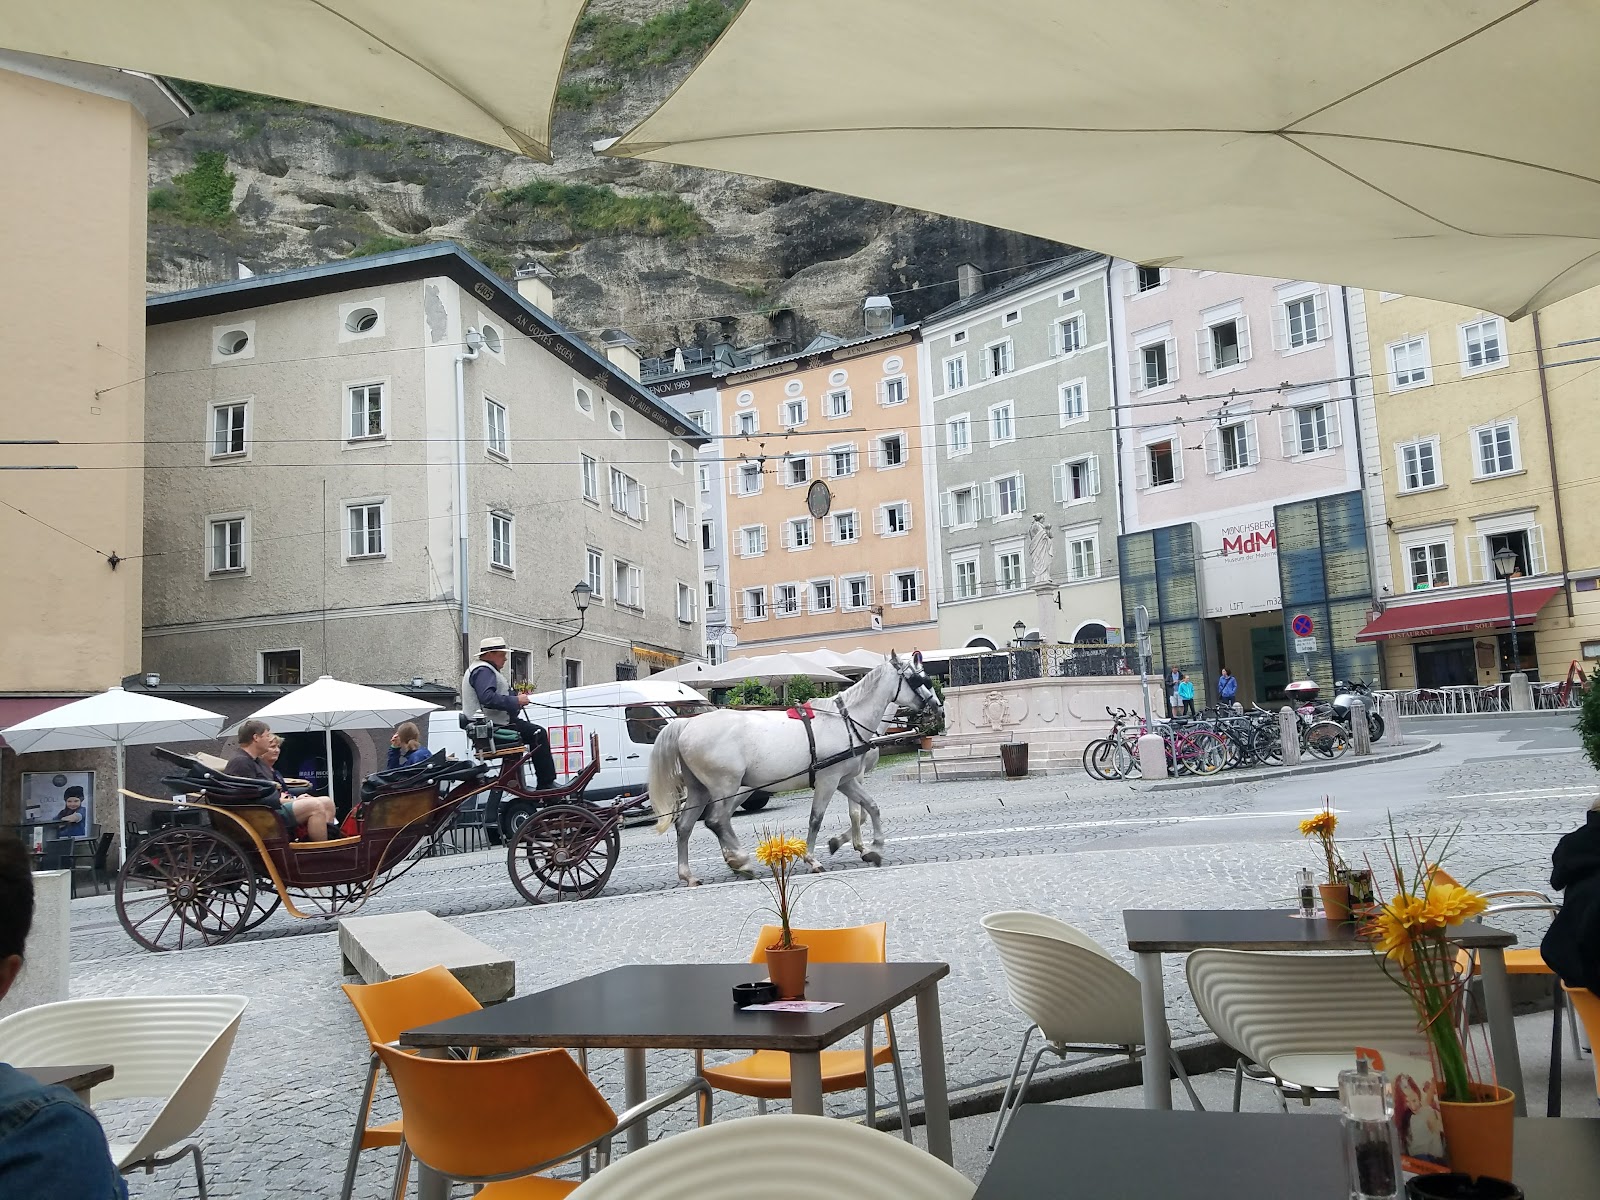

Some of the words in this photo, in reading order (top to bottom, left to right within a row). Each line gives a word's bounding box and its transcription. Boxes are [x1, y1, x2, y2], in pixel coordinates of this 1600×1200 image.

[476, 284, 493, 299] 1405
[514, 314, 528, 327] AN
[648, 383, 673, 394] ENOV.
[674, 380, 690, 390] 1989
[1222, 529, 1276, 557] MdM
[1224, 556, 1245, 564] Museum
[1246, 553, 1254, 561] der
[1229, 601, 1244, 611] LIFT
[1266, 597, 1282, 607] m32
[1388, 629, 1434, 640] RESTAURANT
[1474, 622, 1495, 630] SOLE
